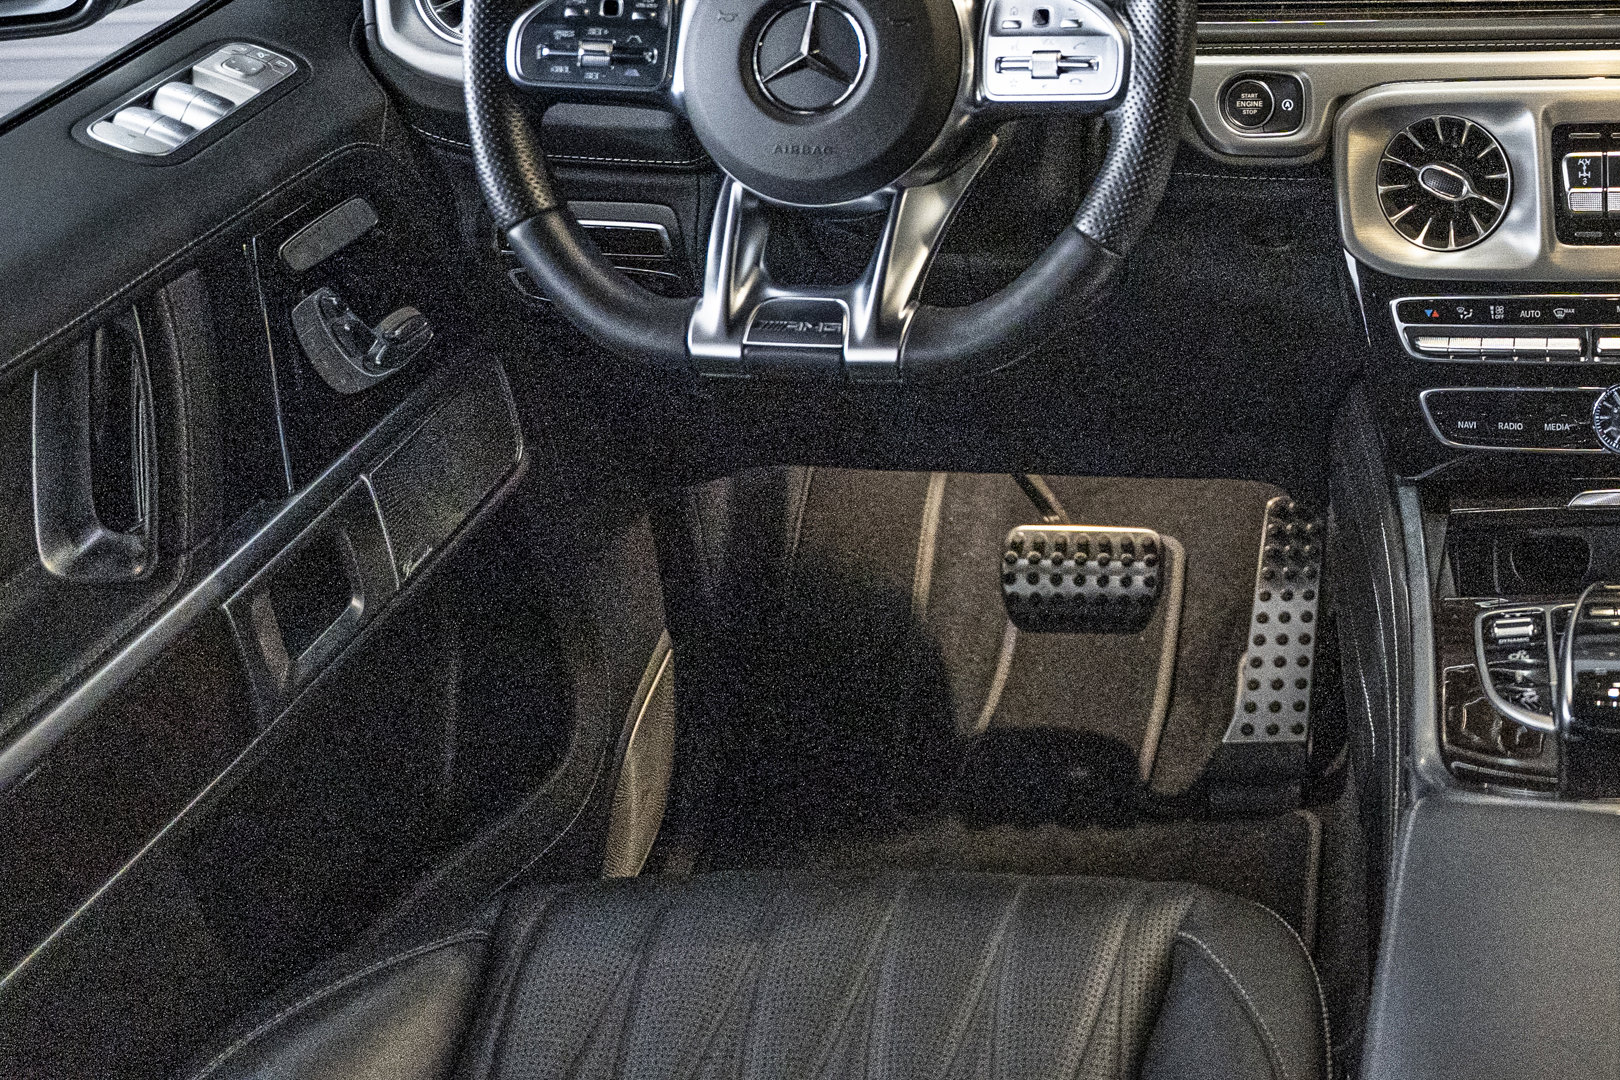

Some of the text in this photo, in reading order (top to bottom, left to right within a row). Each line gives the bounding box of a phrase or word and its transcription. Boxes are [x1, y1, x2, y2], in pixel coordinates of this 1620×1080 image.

[1236, 100, 1264, 108] ENGINE
[1582, 177, 1588, 186] 3
[1520, 309, 1541, 318] AUTO
[1457, 421, 1477, 429] NAVI
[1498, 422, 1524, 431] RADIO
[1544, 423, 1570, 431] MEDIA
